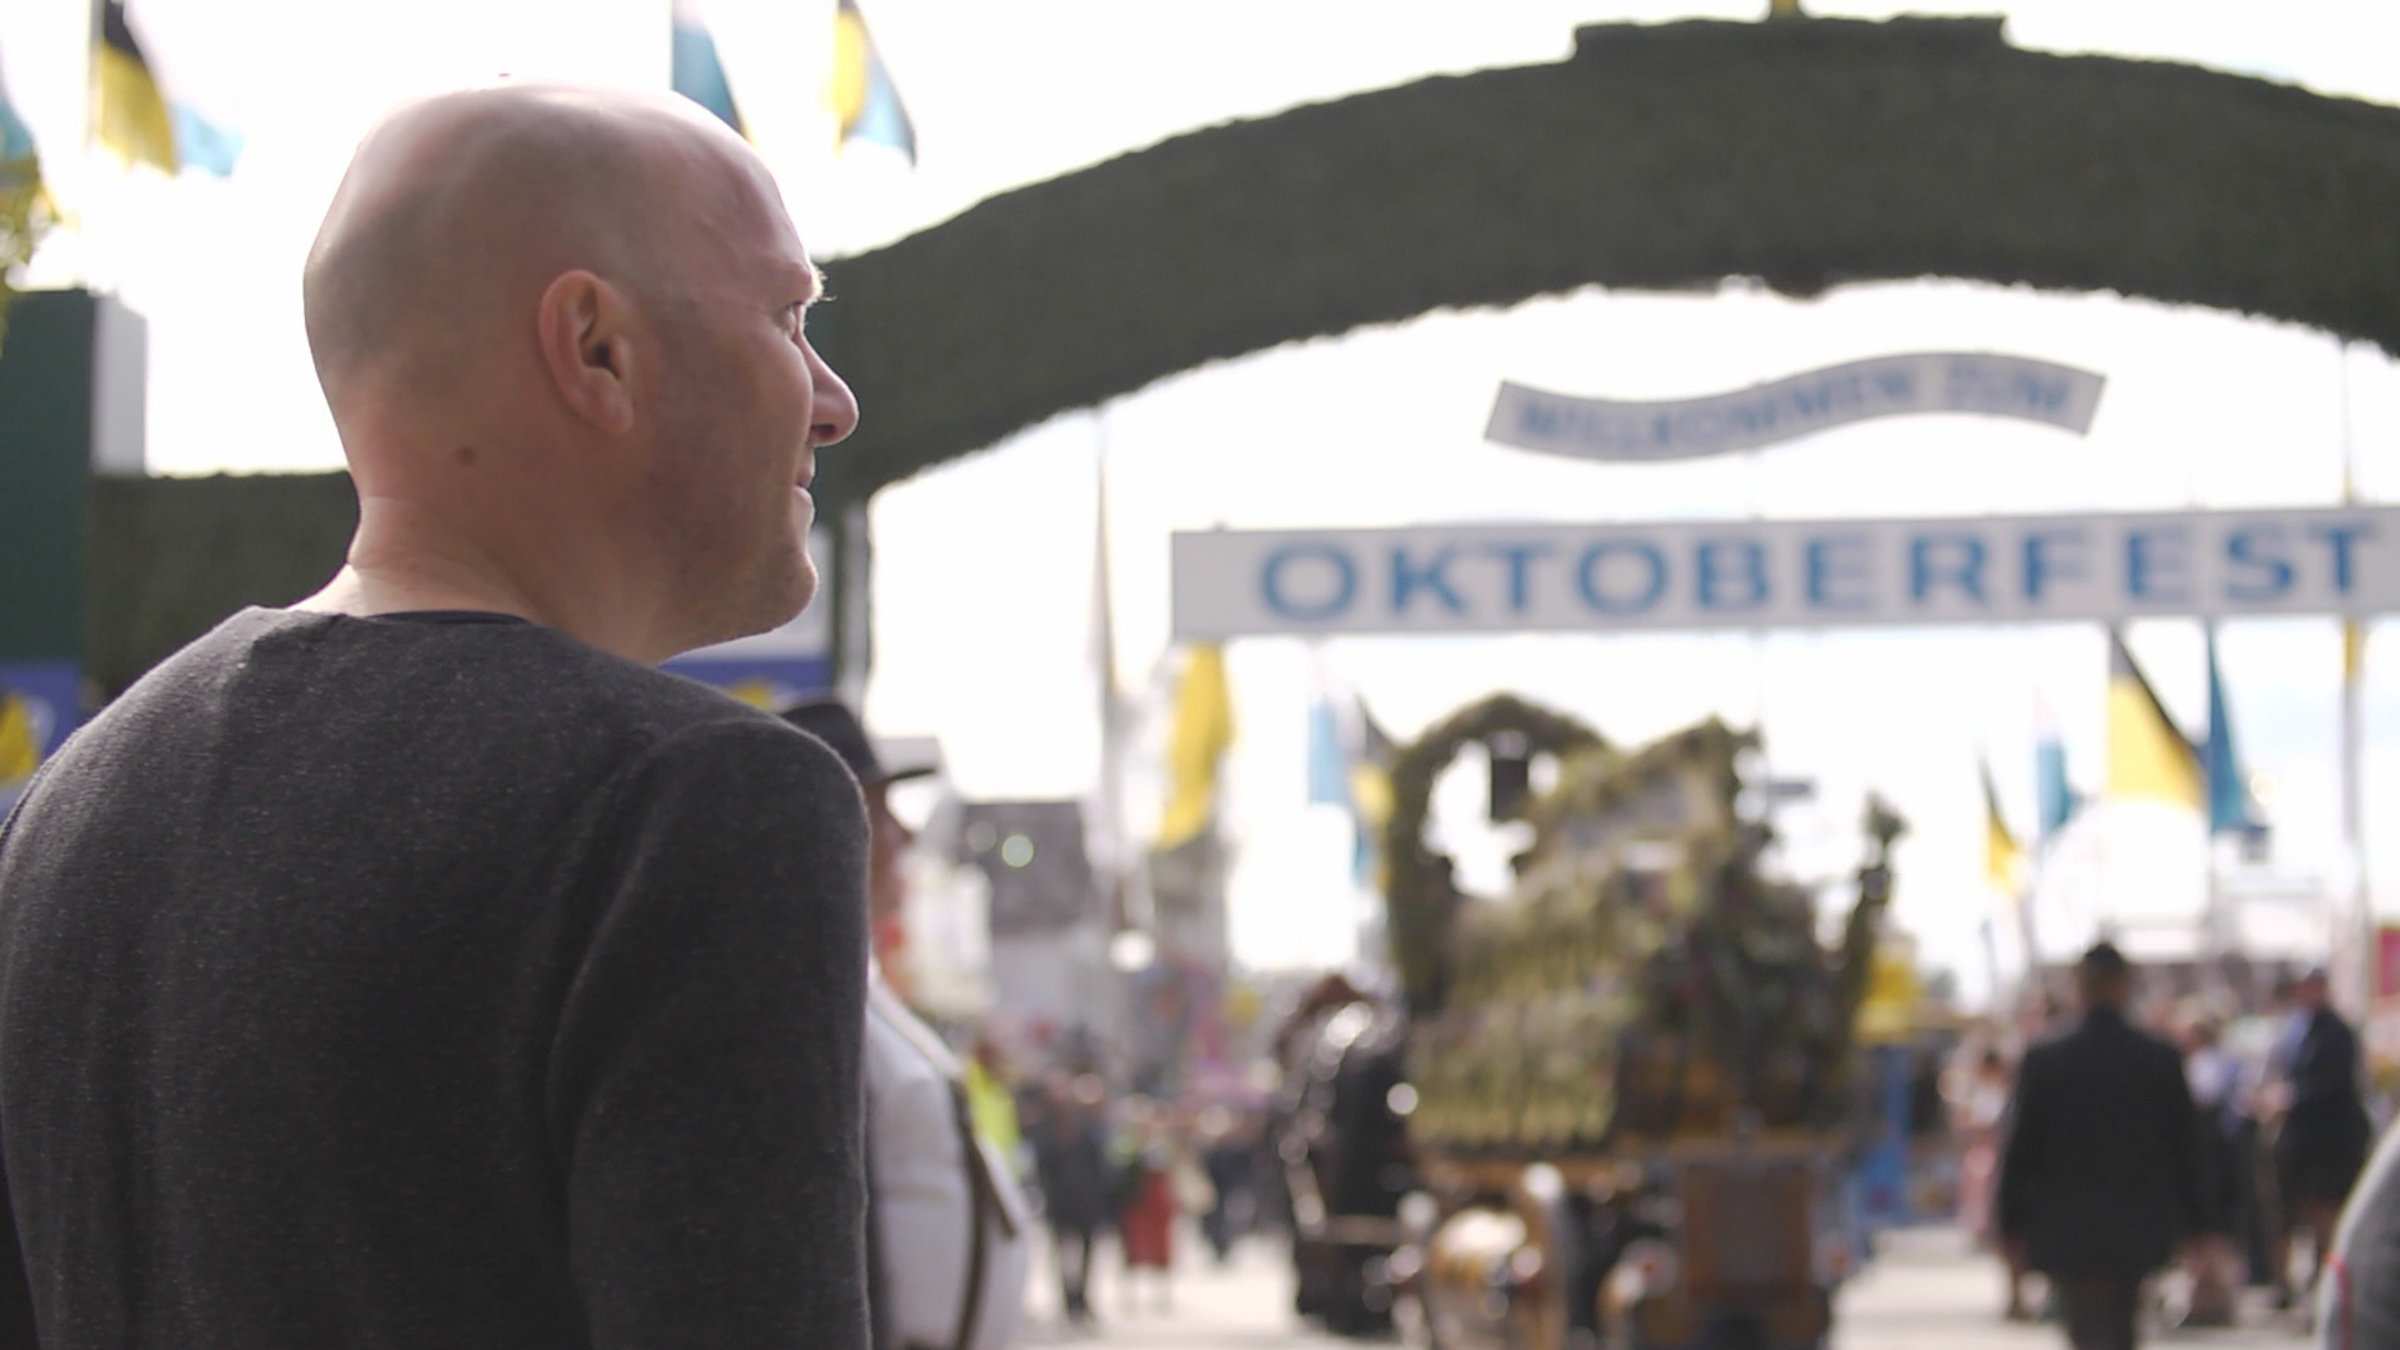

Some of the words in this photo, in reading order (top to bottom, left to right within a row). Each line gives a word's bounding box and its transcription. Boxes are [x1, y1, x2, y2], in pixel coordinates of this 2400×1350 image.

[1518, 362, 1914, 451] WILLKOMMEN
[1944, 359, 2073, 414] ZUM
[1260, 521, 2374, 621] OKTOBERFEST
